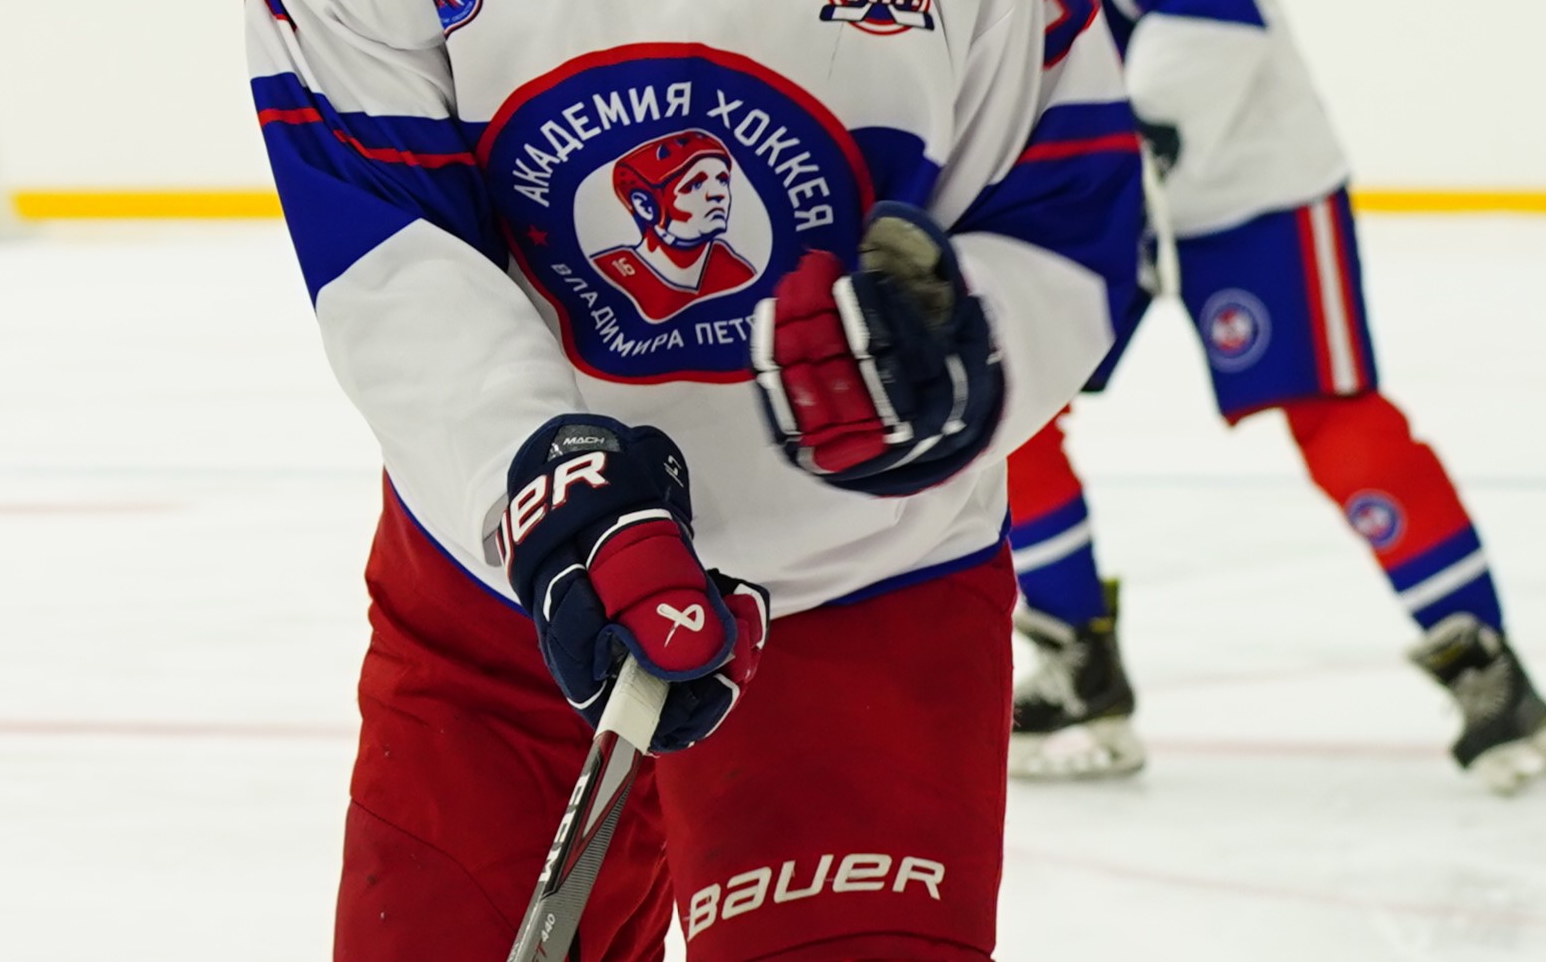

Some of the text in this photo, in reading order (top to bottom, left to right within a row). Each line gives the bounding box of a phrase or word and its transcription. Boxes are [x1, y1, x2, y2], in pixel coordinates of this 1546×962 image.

[513, 82, 834, 232] АКАДЕМИЯ ХОККЕЯ
[551, 263, 684, 357] ВЛАДИМИРА
[563, 436, 604, 445] MACH
[687, 853, 945, 942] BAUER
